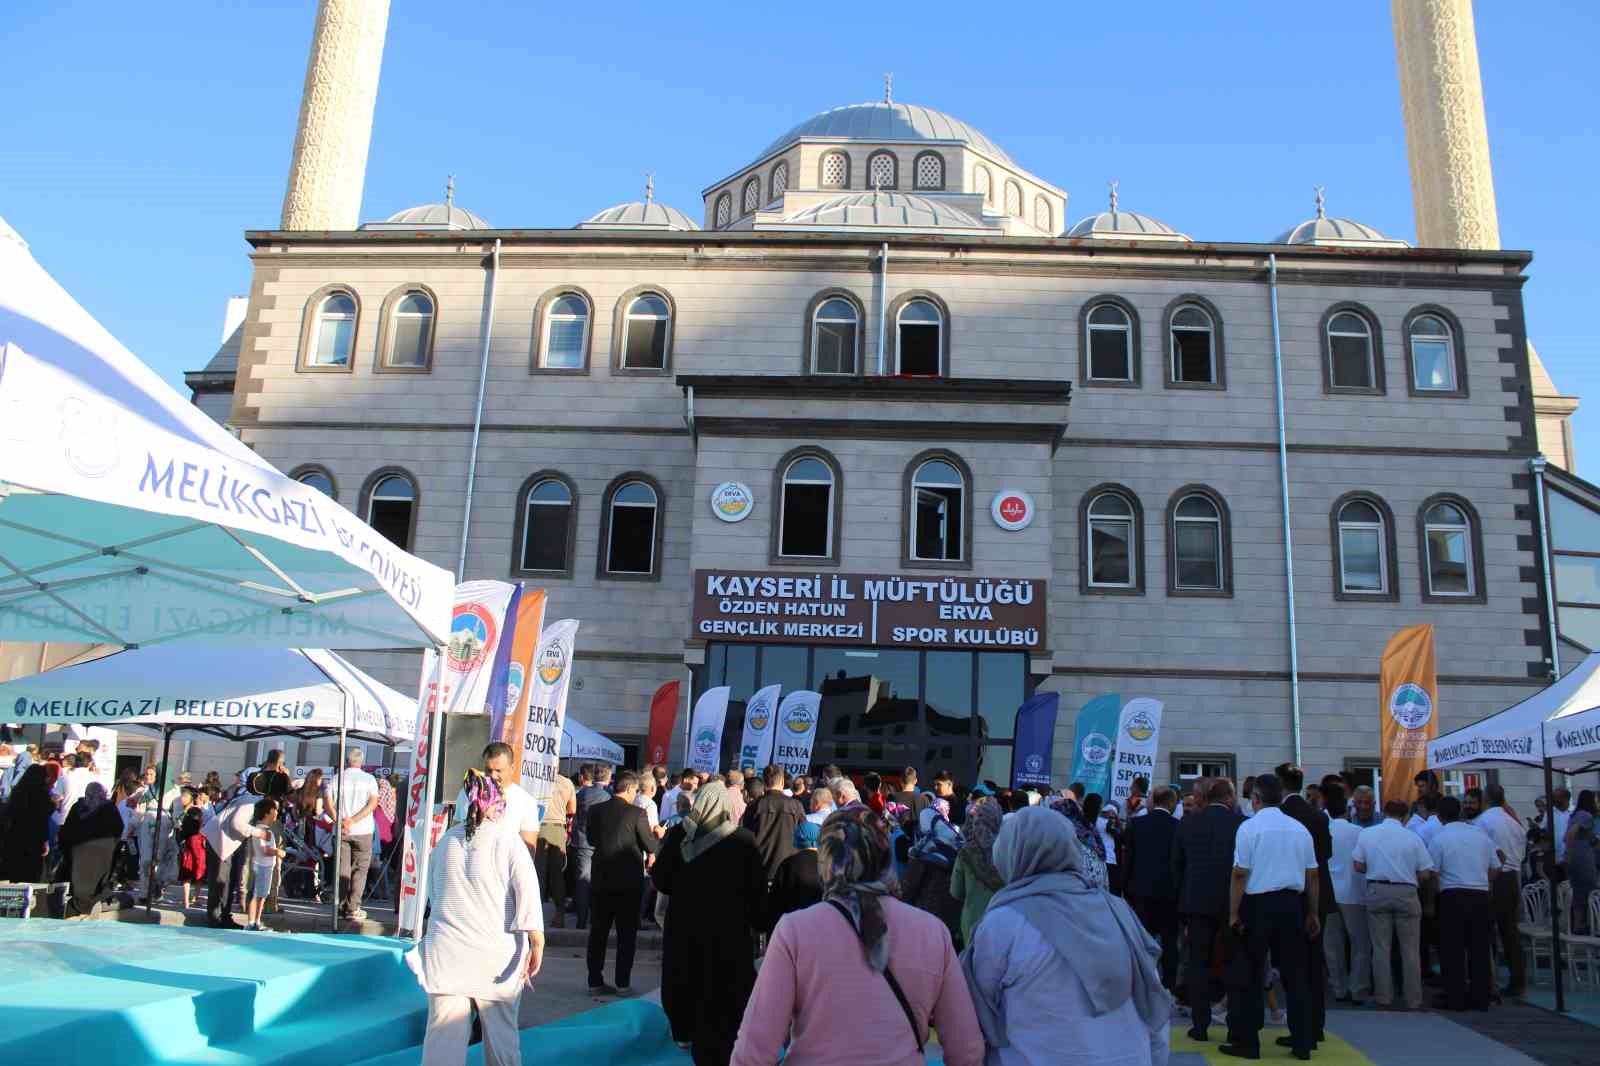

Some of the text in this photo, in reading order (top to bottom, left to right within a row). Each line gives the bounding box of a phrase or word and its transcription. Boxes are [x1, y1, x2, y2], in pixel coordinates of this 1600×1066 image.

[139, 451, 422, 610] MELİKGAZİ BDİYESİ
[707, 574, 1033, 605] KAYSERİ İL MÜFTÜLÜĞÜ
[719, 598, 845, 617] ÖZDEN HATUN
[940, 605, 993, 620] ERVA
[700, 619, 863, 638] GENÇLİK MERKEZİ
[892, 627, 1039, 646] SPOR KULÜBÜ
[30, 697, 299, 719] MELİKGAZİ BELEDİYESİ
[528, 705, 560, 727] ERVA
[525, 733, 557, 756] SPOR
[778, 745, 809, 758] ERVA
[1119, 751, 1152, 766] ERVA
